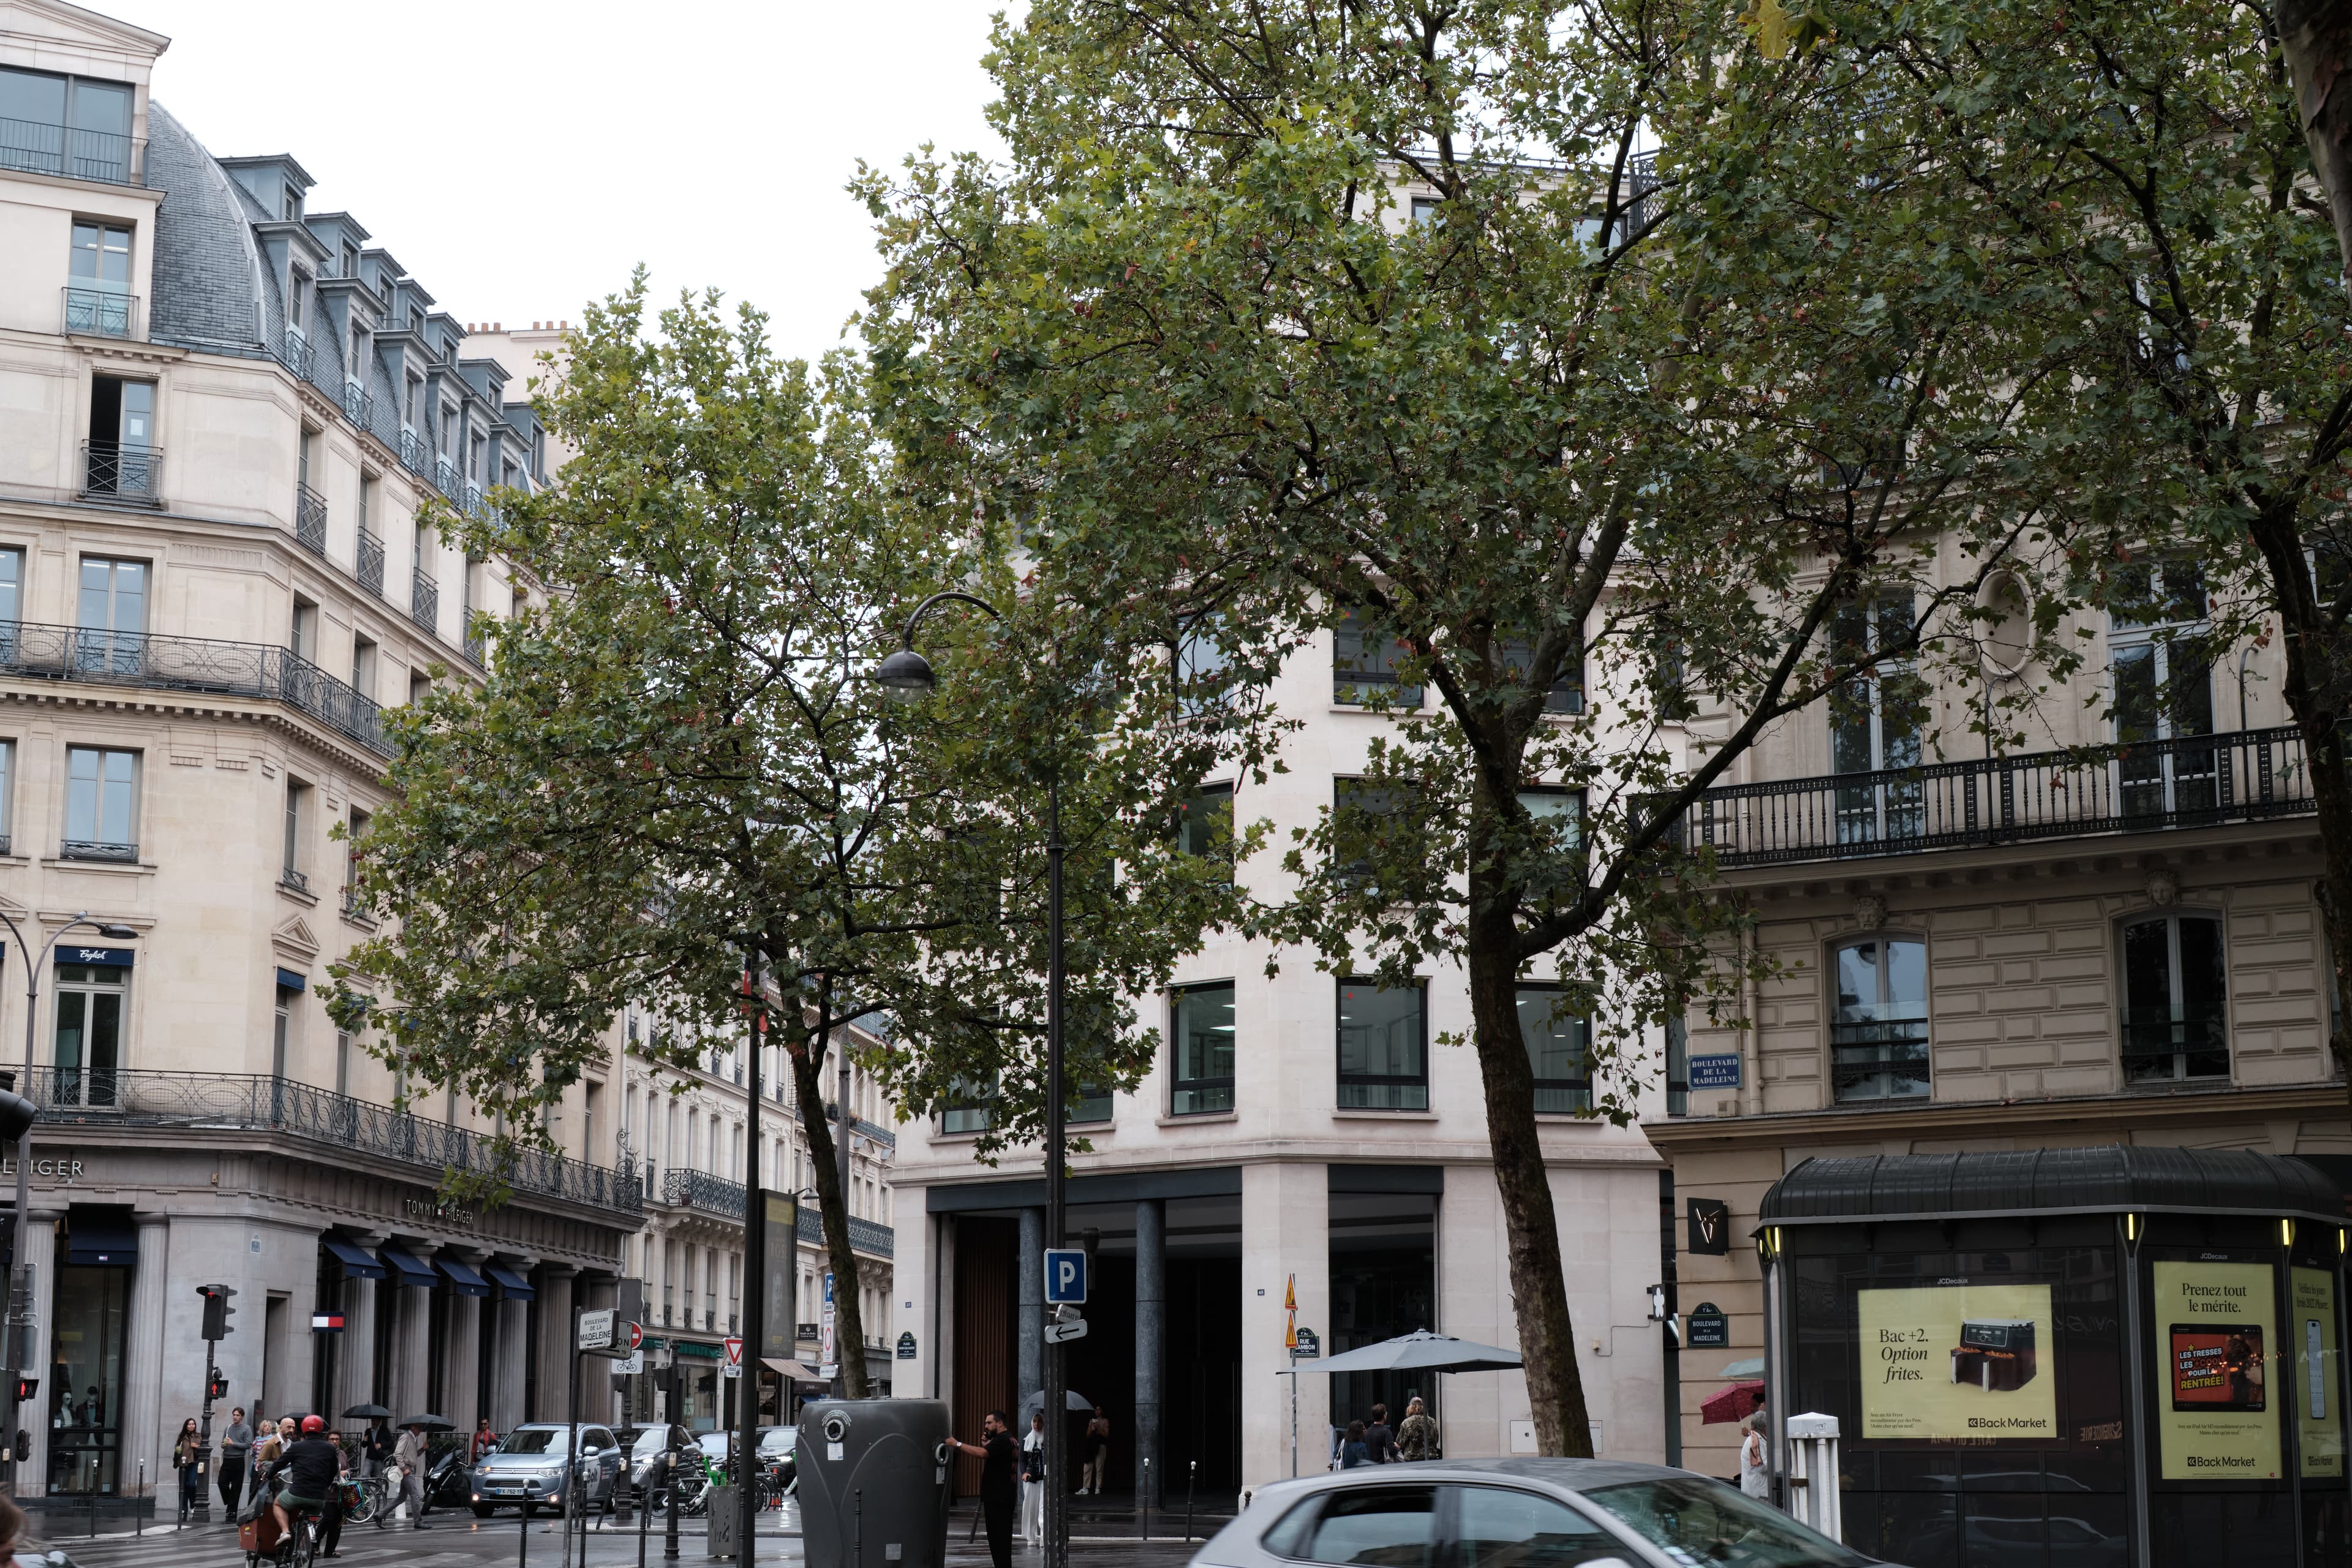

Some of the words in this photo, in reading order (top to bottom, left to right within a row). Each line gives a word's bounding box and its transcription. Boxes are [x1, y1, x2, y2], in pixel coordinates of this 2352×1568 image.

[79, 949, 107, 962] English
[1692, 1058, 1738, 1068] BOULEVARD
[1693, 1076, 1738, 1084] MADELEINE
[406, 1199, 436, 1216] TOMMY
[1059, 1261, 1076, 1293] P
[2182, 1283, 2221, 1296] Prenez
[2224, 1285, 2247, 1297] tout
[2188, 1299, 2199, 1312] le
[2201, 1300, 2242, 1313] mérite.
[579, 1330, 611, 1342] MADELEINE
[1879, 1329, 1905, 1343] Bac
[1908, 1328, 1929, 1343] +2.
[1881, 1346, 1928, 1364] Option
[2193, 1348, 2222, 1357] TRESSES
[1883, 1366, 1923, 1384] frites.
[2180, 1374, 2224, 1390] RENTRÉE!
[1979, 1418, 2006, 1428] Back
[2008, 1418, 2047, 1428] Market
[2197, 1457, 2221, 1466] Back
[2222, 1457, 2256, 1466] Market
